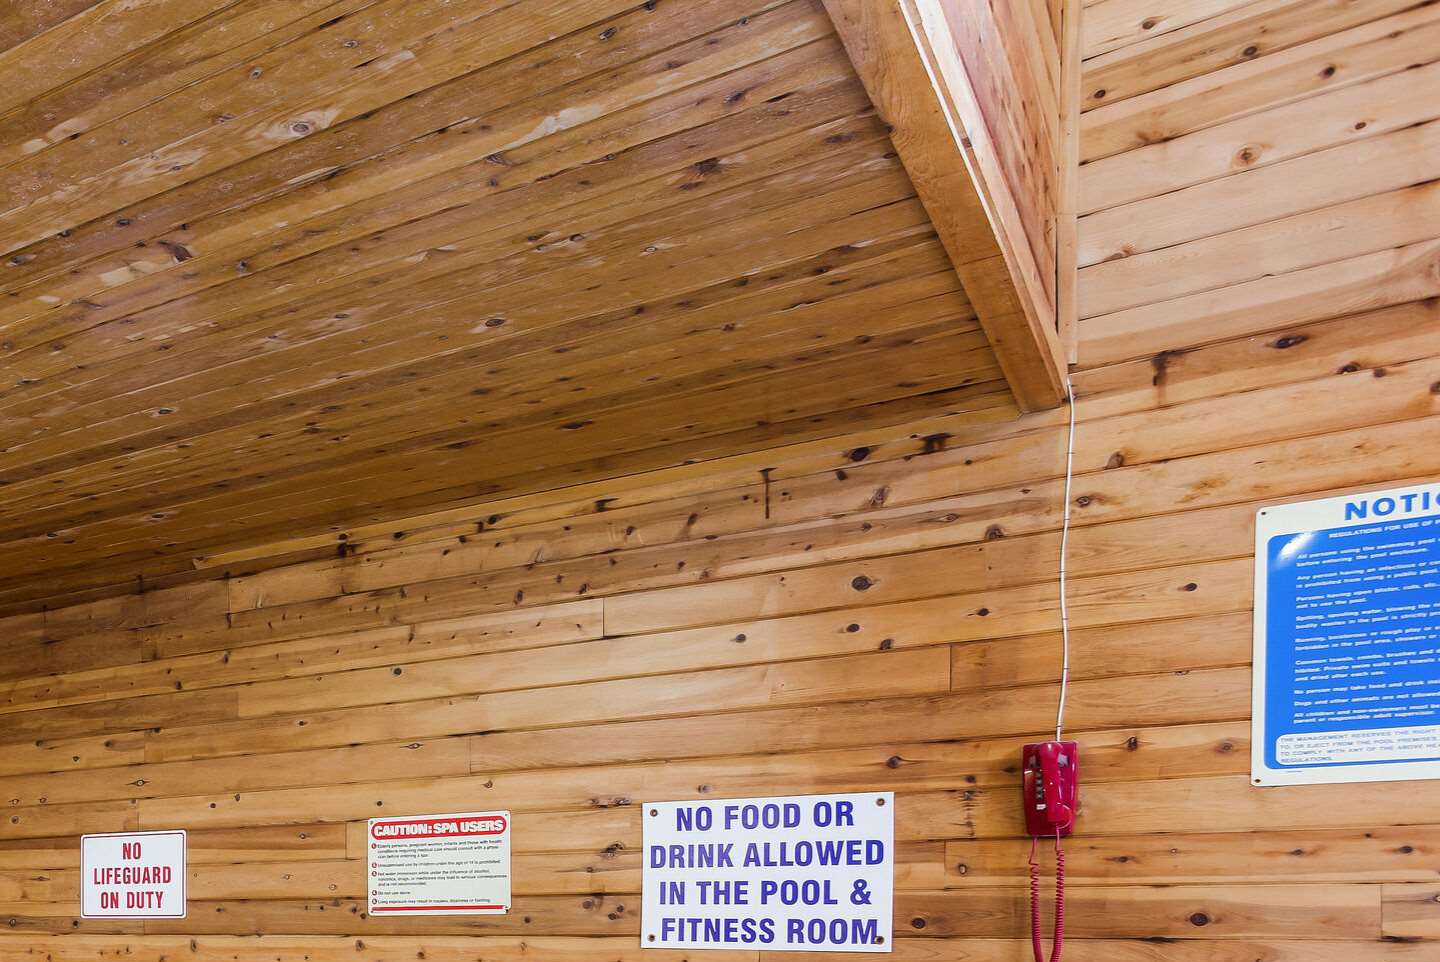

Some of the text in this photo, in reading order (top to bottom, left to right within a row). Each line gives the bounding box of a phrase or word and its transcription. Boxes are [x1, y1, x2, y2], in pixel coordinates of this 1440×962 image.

[676, 801, 854, 831] NO FOOD OR
[374, 820, 504, 837] CAUTION: SPA USERS
[122, 842, 142, 860] NO
[650, 839, 884, 868] DRINK ALLOWED
[94, 866, 171, 885] LIFEGUARD
[101, 891, 164, 909] ON DUTY
[659, 878, 872, 905] IN THE POOL &
[661, 918, 775, 943] FITNESS
